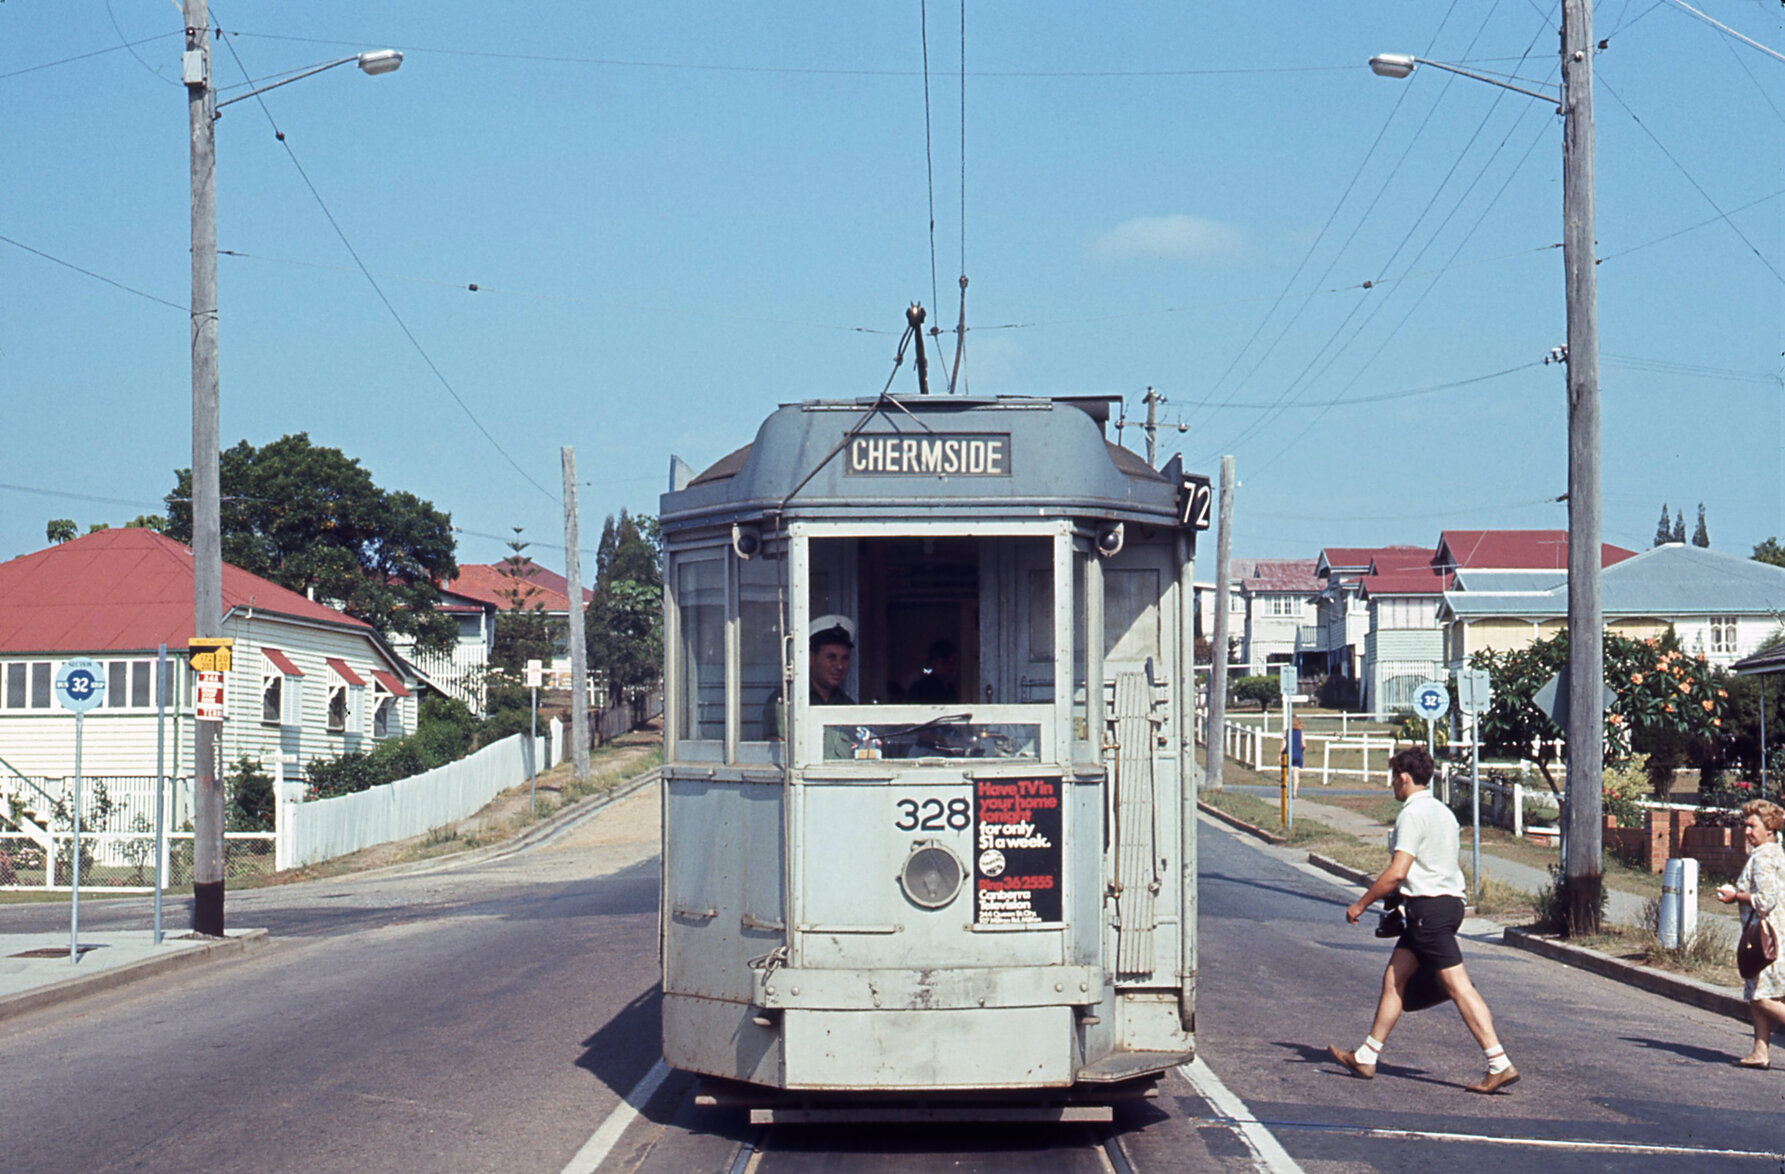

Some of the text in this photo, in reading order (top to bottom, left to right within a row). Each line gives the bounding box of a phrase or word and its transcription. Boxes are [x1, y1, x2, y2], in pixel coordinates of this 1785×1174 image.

[852, 438, 1003, 474] CHERMSIDE
[1183, 481, 1211, 526] 72
[72, 677, 89, 693] 32
[1424, 695, 1438, 706] 32
[978, 780, 1054, 796] Have TV in
[979, 795, 1058, 812] your home
[895, 798, 971, 831] 328
[979, 808, 1032, 825] tonight
[979, 819, 1035, 838] for only
[995, 837, 1006, 849] a
[1006, 833, 1052, 849] week.
[978, 875, 1054, 892] Ring 36 2555
[978, 888, 1032, 900] Canberra
[978, 899, 1032, 911] Television
